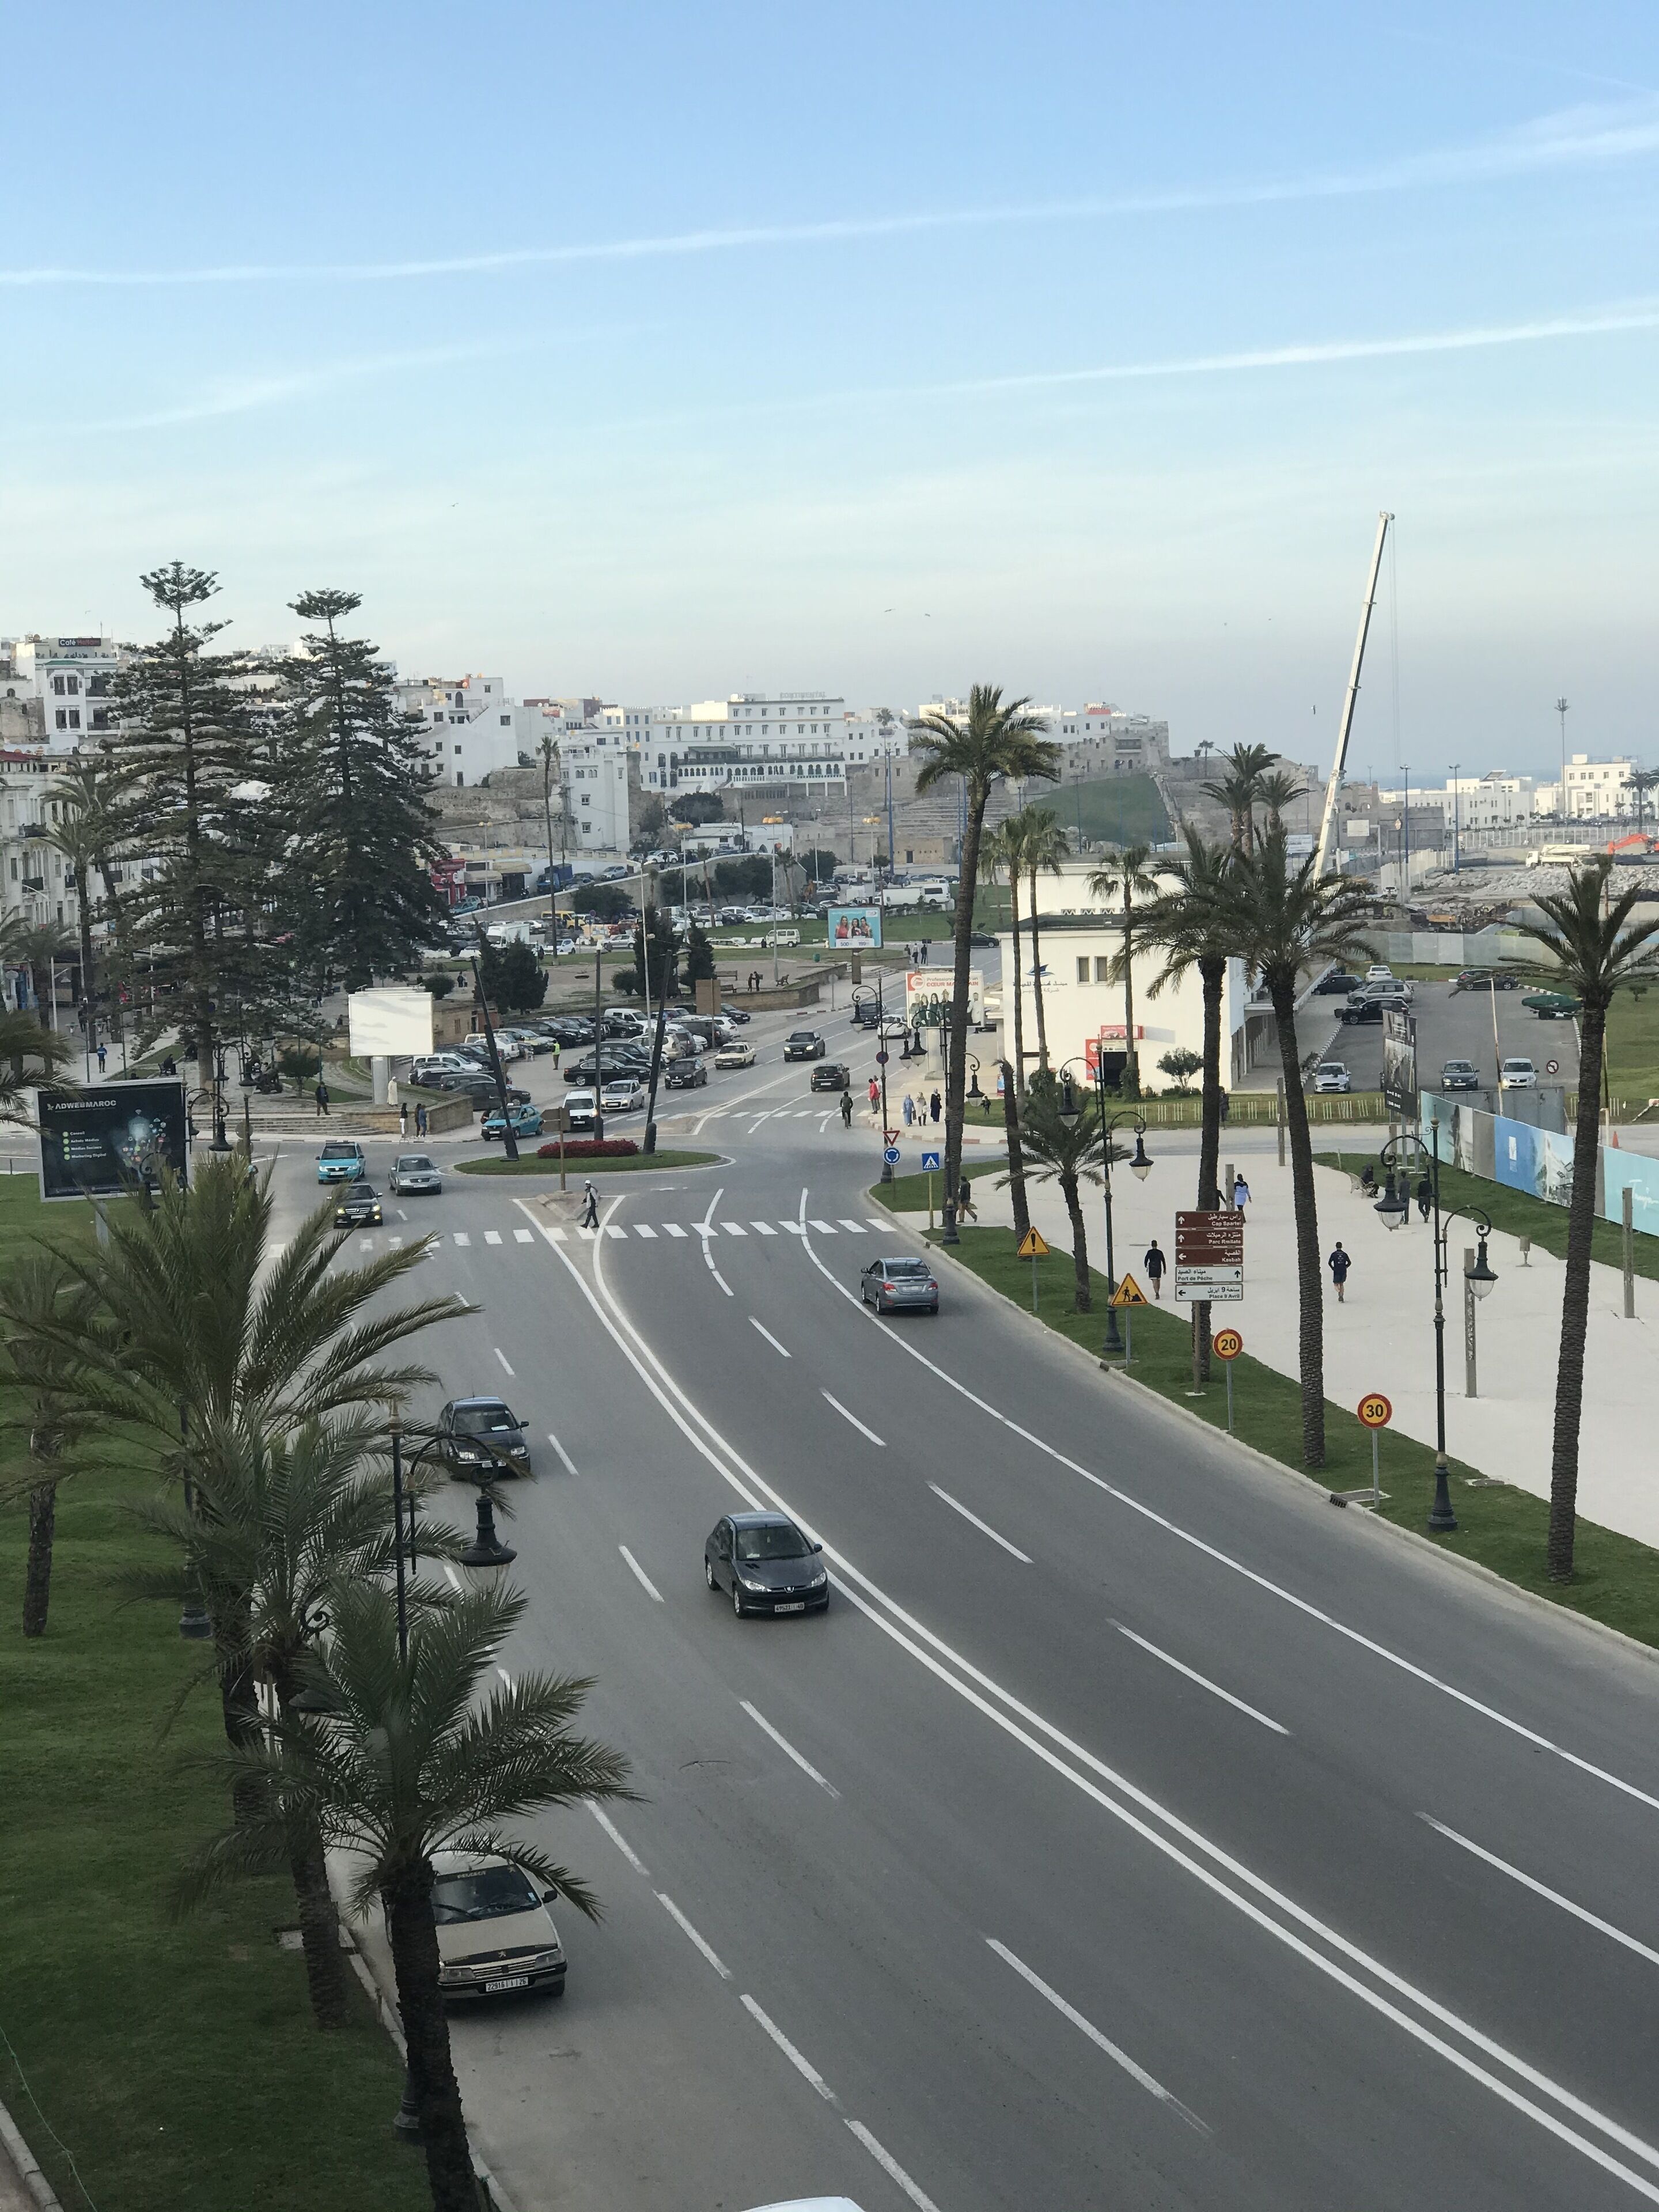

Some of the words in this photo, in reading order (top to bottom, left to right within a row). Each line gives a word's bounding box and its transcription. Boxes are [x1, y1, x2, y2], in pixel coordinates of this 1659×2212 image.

[55, 1100, 117, 1110] ADWEBMAROC
[1221, 1338, 1236, 1350] 20
[1366, 1404, 1384, 1418] 30
